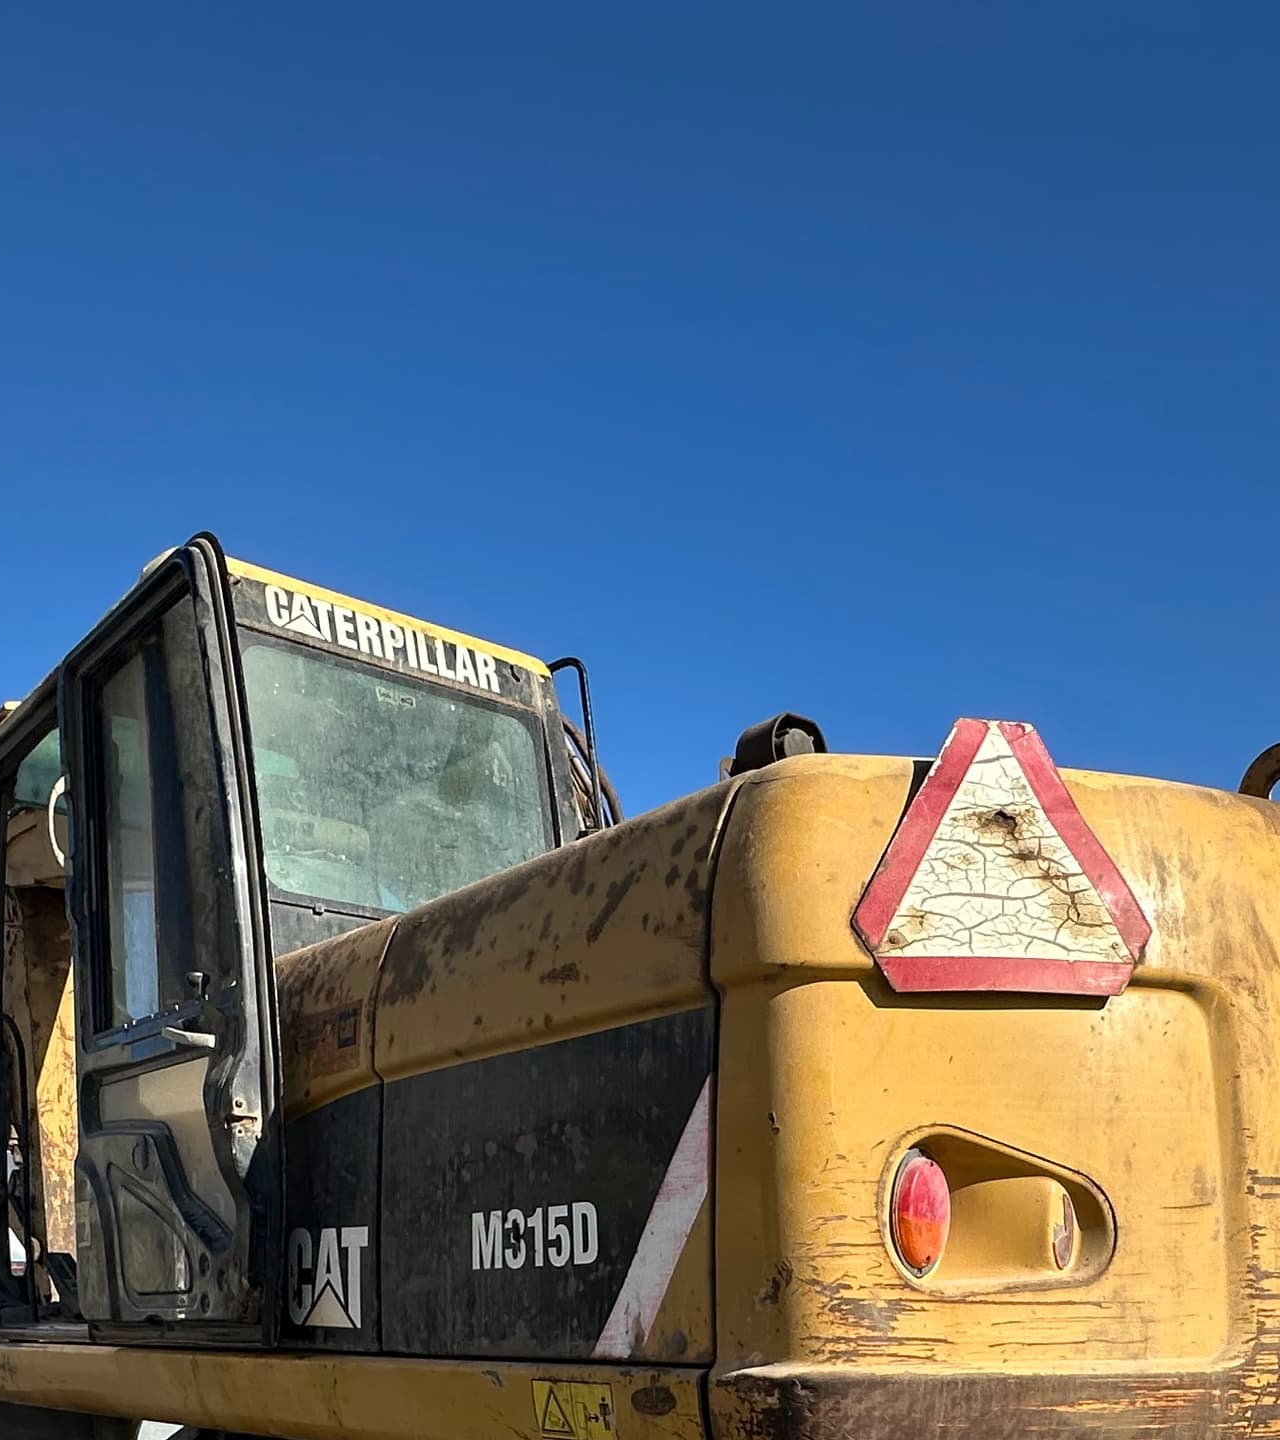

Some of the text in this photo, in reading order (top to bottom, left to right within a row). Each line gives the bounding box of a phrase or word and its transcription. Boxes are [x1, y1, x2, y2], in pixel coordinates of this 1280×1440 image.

[265, 584, 500, 693] CATERPILLAR
[288, 1226, 369, 1329] CAT
[471, 1201, 599, 1270] M315D
